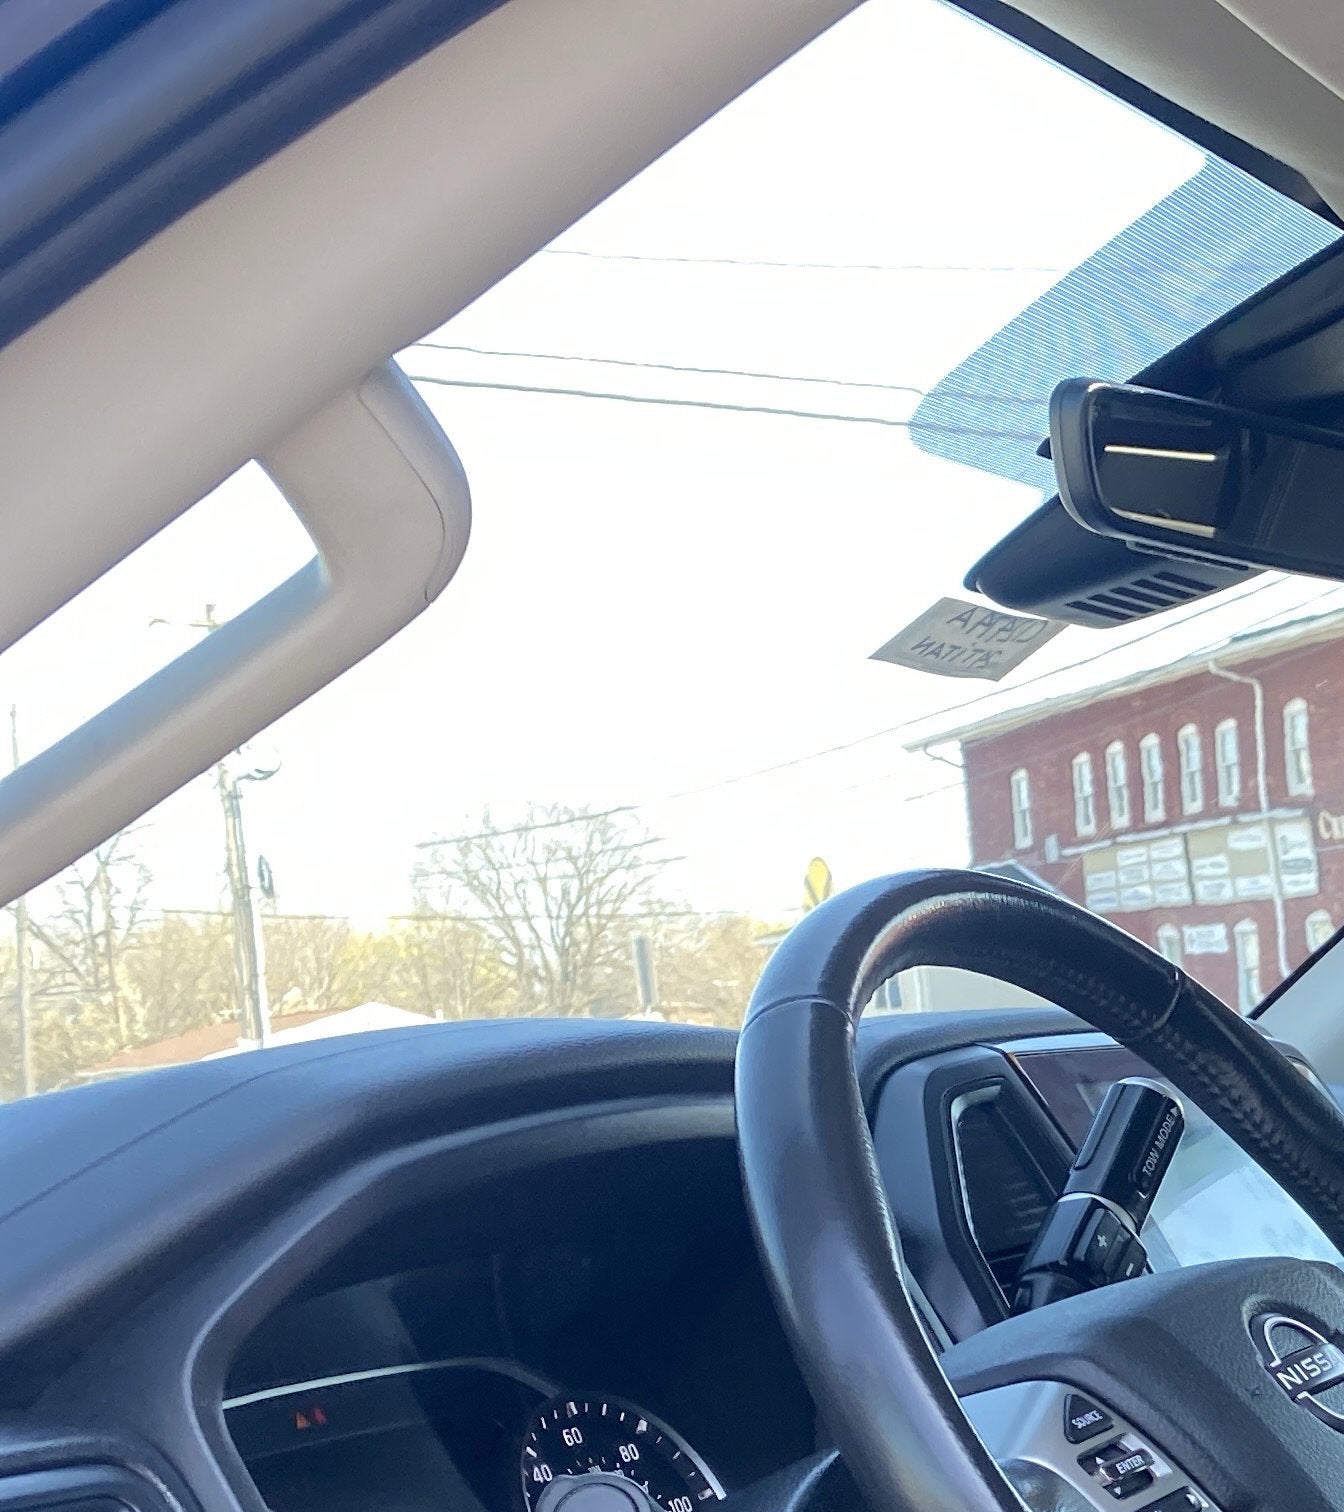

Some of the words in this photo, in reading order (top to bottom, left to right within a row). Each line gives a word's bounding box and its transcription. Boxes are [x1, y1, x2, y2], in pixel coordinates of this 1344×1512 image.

[1142, 1148, 1159, 1177] TOW
[1154, 1113, 1175, 1150] MODE
[1071, 1410, 1103, 1429] SOURCE
[562, 1427, 583, 1447] 60
[618, 1443, 640, 1463] 80
[533, 1464, 553, 1484] 40
[1115, 1454, 1145, 1474] ENTER
